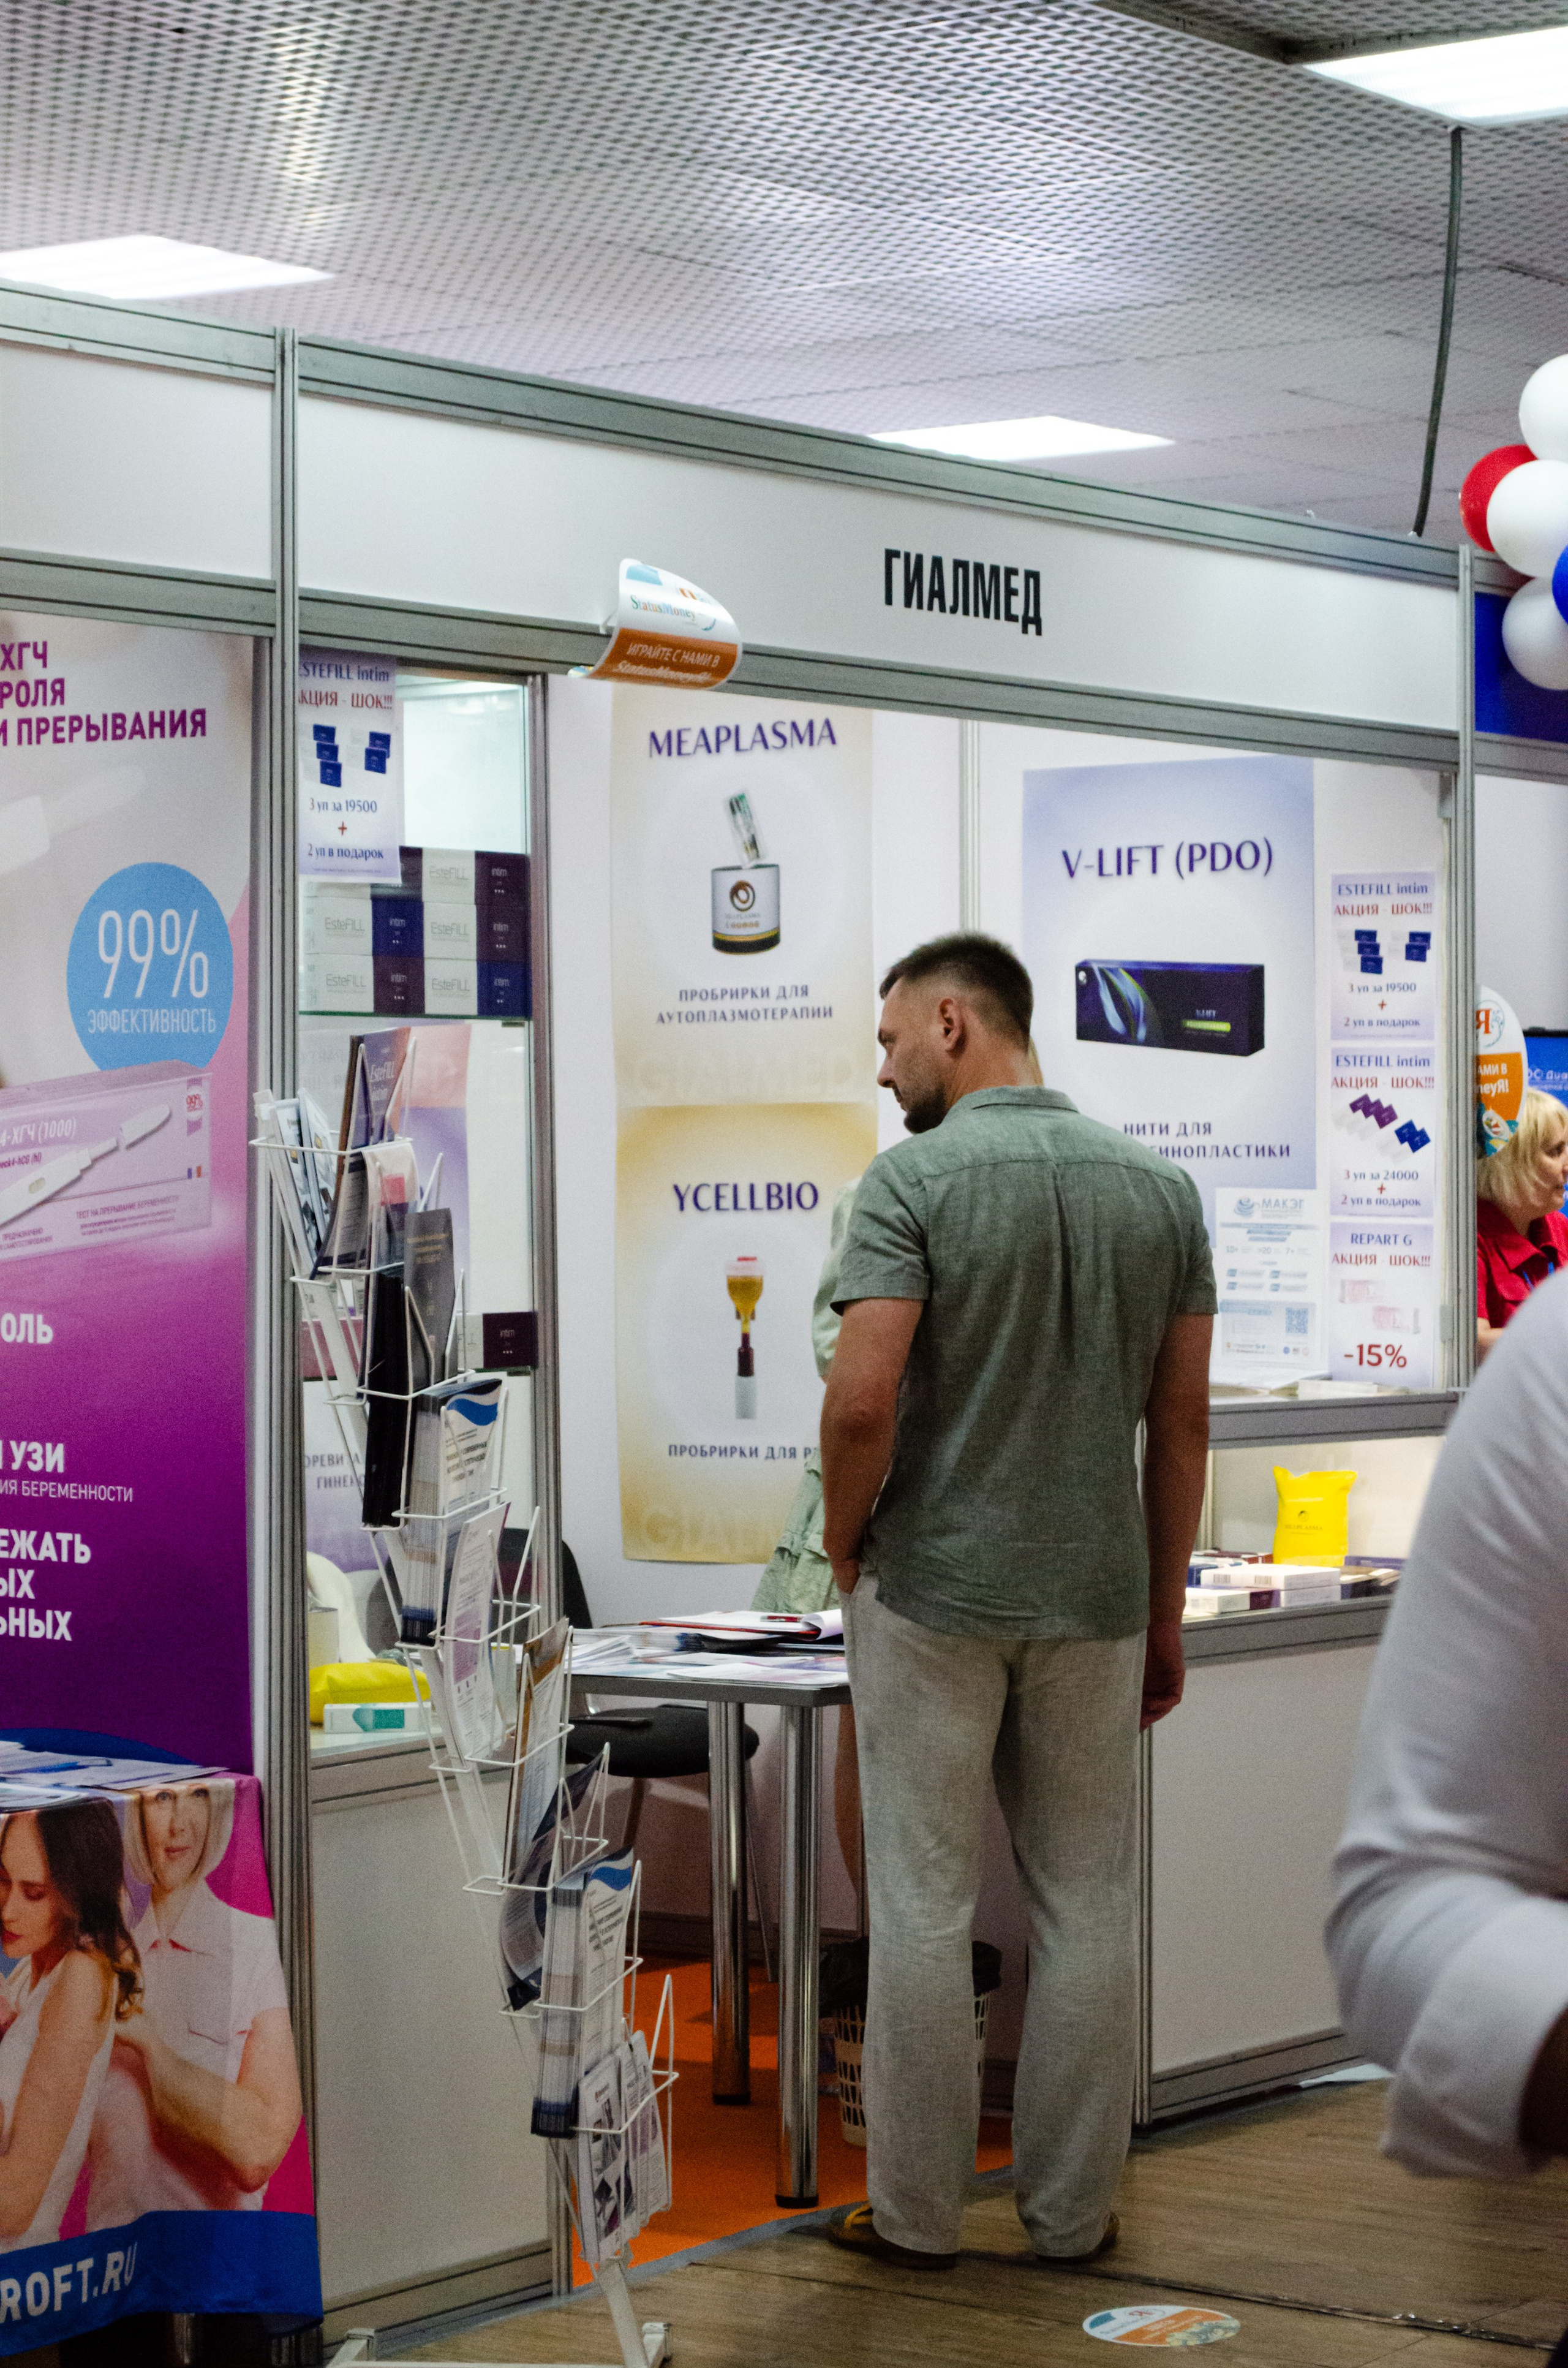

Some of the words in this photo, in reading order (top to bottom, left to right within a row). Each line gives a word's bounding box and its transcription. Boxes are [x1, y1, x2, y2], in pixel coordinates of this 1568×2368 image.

[884, 548, 1042, 635] ГИАЛМЕД
[0, 641, 48, 671] ХГЧ
[627, 642, 672, 662] ИГРАЙТЕ
[673, 649, 682, 662] С
[680, 650, 712, 667] НАМИ
[712, 656, 720, 668] В
[356, 665, 390, 682] intim
[0, 678, 65, 708] РОЛЯ
[350, 692, 393, 709] ШОК!!!
[17, 708, 206, 746] ПРЕРЫВАНИЯ
[649, 718, 837, 758] MEAPLASMA
[309, 797, 315, 810] 3
[317, 800, 328, 813] уп
[331, 801, 342, 812] за
[345, 800, 377, 813] 19500
[307, 843, 313, 857] 2
[315, 846, 326, 860] уп
[328, 847, 334, 857] в
[337, 847, 384, 861] подарок
[1062, 844, 1164, 879] V-LIFT
[1175, 837, 1273, 880] (PDO)
[1338, 883, 1392, 896] ESTEFILL
[1396, 882, 1428, 895] intim
[1334, 903, 1379, 917] АКЦИЯ
[1391, 902, 1432, 915] ШОК!!!
[99, 909, 208, 998] 99%
[679, 986, 771, 1002] ПРОБРИРКИ
[775, 985, 809, 1001] ДЛЯ
[1349, 983, 1354, 993] 3
[1357, 984, 1368, 994] уп
[1372, 984, 1382, 993] за
[1386, 983, 1417, 993] 19500
[88, 1008, 216, 1034] ЭФФЕКТИВНОСТЬ
[656, 1005, 833, 1024] АУТОПЛАЗМОТЕРАПИИ
[1344, 1017, 1349, 1027] 2
[1352, 1018, 1365, 1029] уп
[1376, 1018, 1420, 1029] подарок
[1336, 1054, 1392, 1067] ESTEFILL
[1396, 1054, 1430, 1067] intim
[1477, 1064, 1499, 1075] АМИ
[1332, 1076, 1378, 1090] АКЦИЯ
[1391, 1076, 1434, 1089] ШОК!!!
[39, 1116, 77, 1144] (1000)
[1124, 1123, 1169, 1136] НИТИ
[1176, 1122, 1212, 1138] ДЛЯ
[1150, 1144, 1291, 1159] ИНОПЛАСТИКИ
[1344, 1170, 1350, 1180] 3
[1354, 1171, 1365, 1181] уп
[1370, 1171, 1380, 1180] за
[1384, 1170, 1419, 1181] 24000
[673, 1182, 820, 1213] YCELLBIO
[1341, 1194, 1347, 1205] 2
[1351, 1195, 1363, 1206] уп
[1376, 1197, 1421, 1207] подарок
[1351, 1233, 1399, 1246] REPART
[1403, 1234, 1412, 1246] G
[1332, 1253, 1377, 1266] АКЦИЯ
[1389, 1255, 1430, 1267] ШОК!!!
[1, 1312, 54, 1344] ОЛЬ
[1344, 1344, 1407, 1368] -15%
[9, 1440, 64, 1473] УЗИ
[668, 1443, 759, 1459] ПРОБРИРКИ
[764, 1445, 797, 1461] ДЛЯ
[22, 1480, 133, 1502] БЕРЕМЕННОСТИ
[0, 1529, 91, 1564] ЕЖАТЬ
[0, 2241, 138, 2324] ROFT.RU
